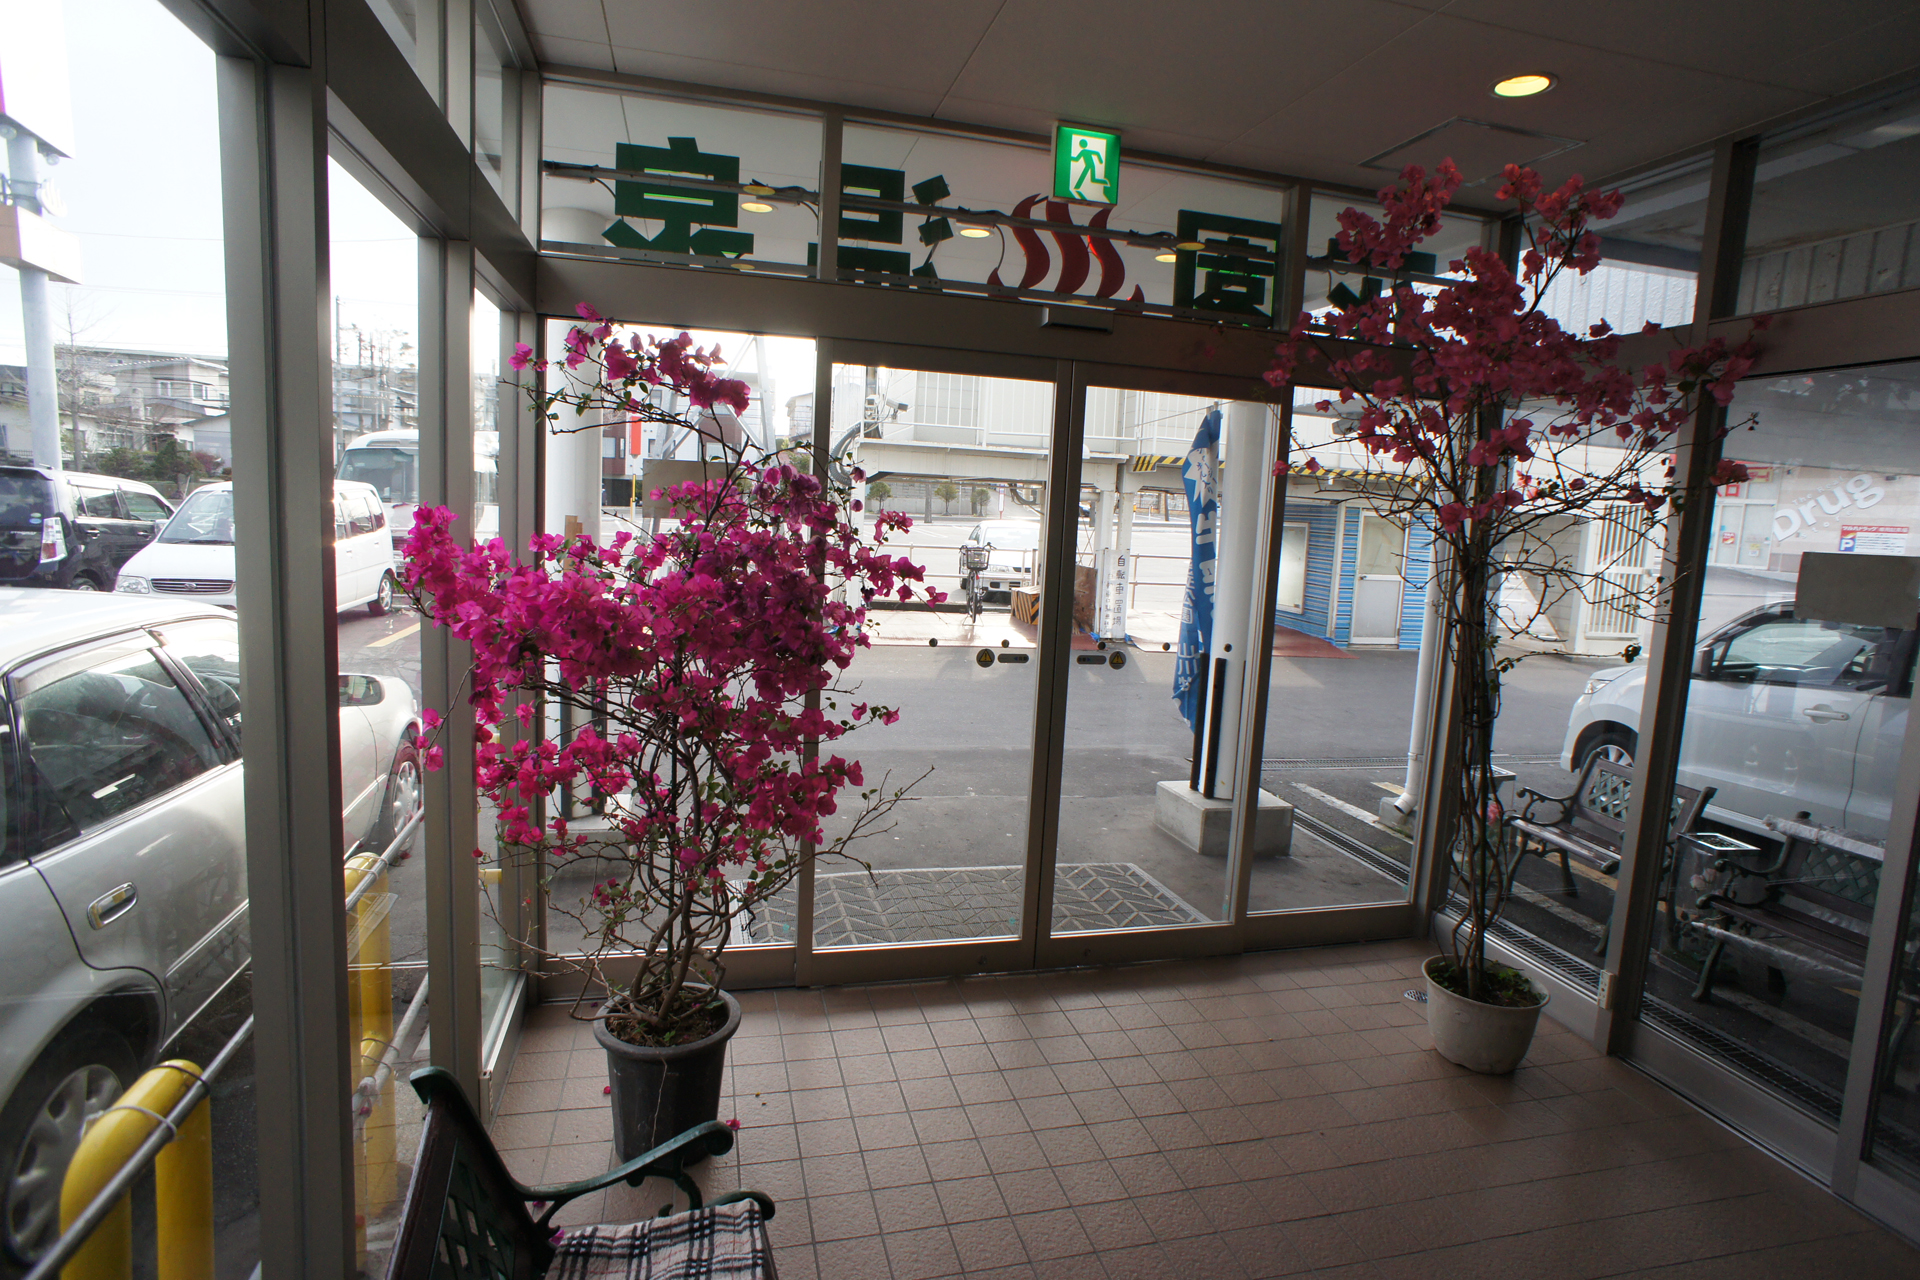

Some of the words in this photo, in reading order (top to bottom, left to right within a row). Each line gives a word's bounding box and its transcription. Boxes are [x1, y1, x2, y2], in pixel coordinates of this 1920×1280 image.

[1773, 474, 1886, 542] Drug
[1840, 539, 1855, 551] P
[1111, 554, 1126, 627] 自転車置場
